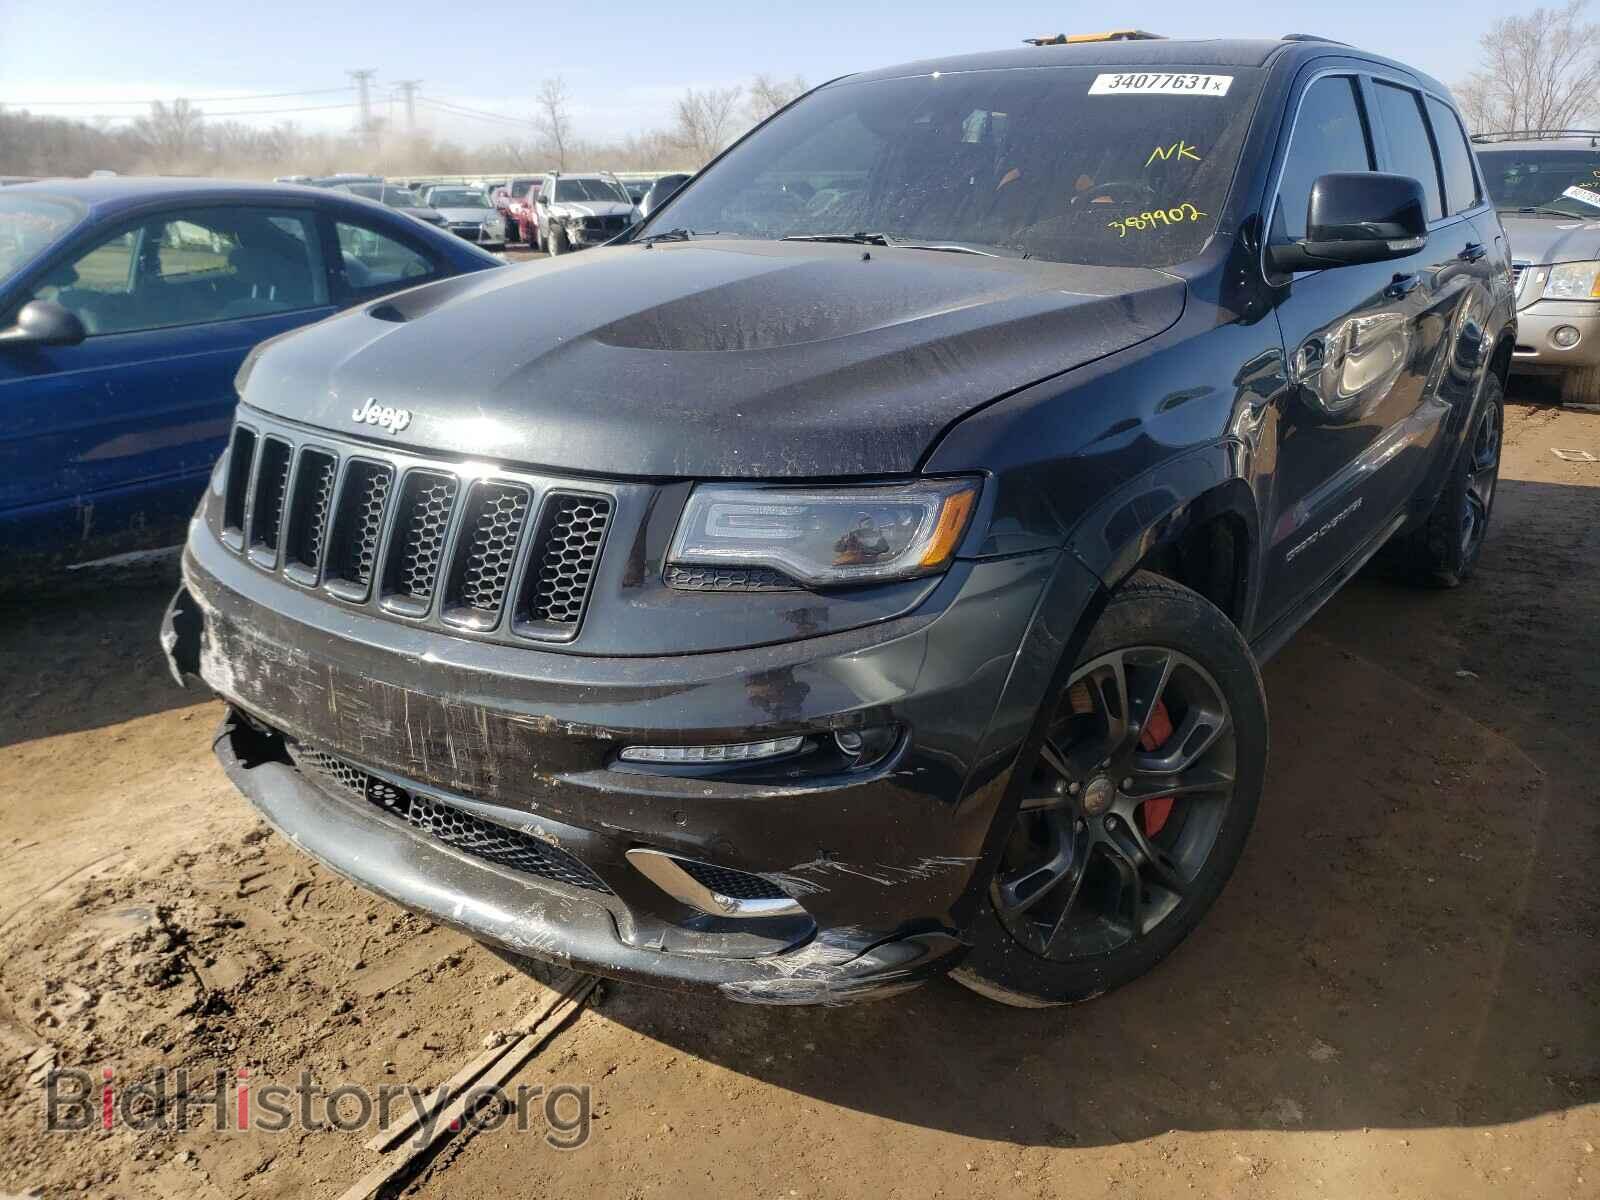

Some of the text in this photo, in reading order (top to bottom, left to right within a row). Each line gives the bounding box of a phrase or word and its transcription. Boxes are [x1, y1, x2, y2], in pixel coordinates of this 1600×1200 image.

[1145, 140, 1202, 168] NK
[1107, 203, 1208, 238] 389902
[351, 397, 411, 435] Jeep
